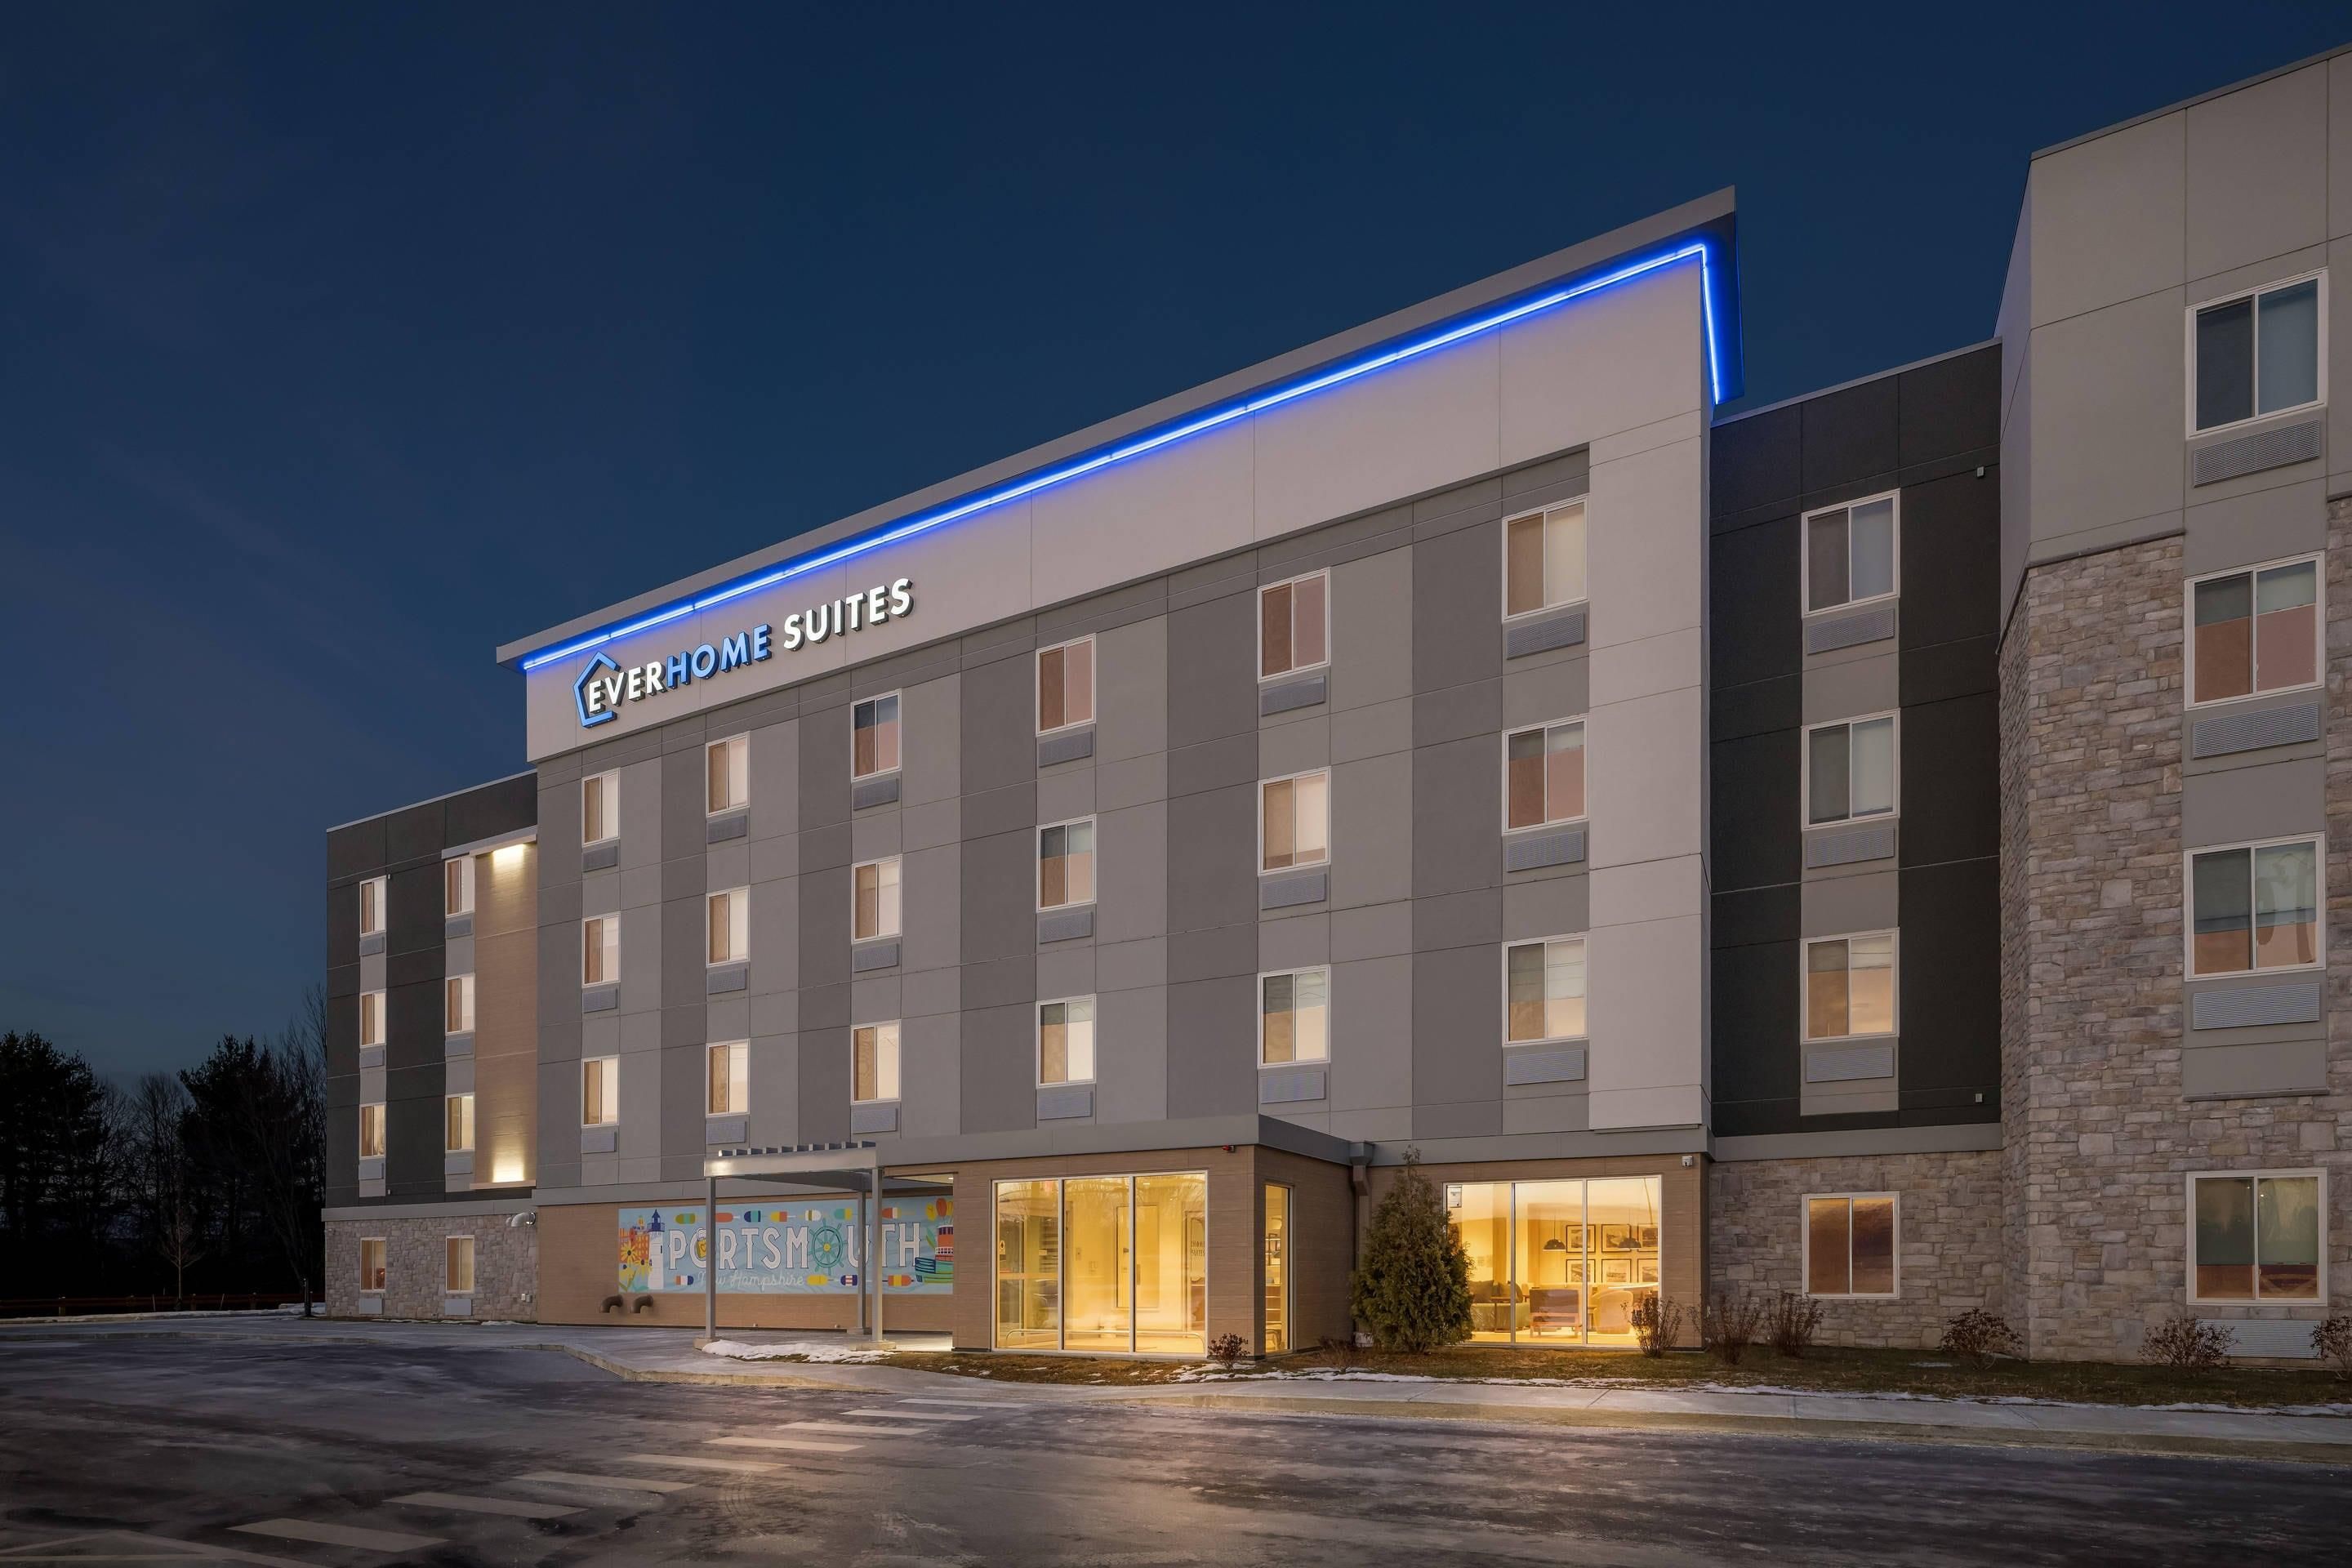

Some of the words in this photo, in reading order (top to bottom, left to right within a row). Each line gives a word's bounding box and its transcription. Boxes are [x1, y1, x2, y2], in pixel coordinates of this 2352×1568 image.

[588, 624, 772, 714] EVERHOME
[783, 577, 914, 652] SUITES
[730, 1269, 804, 1290] Hampshire
